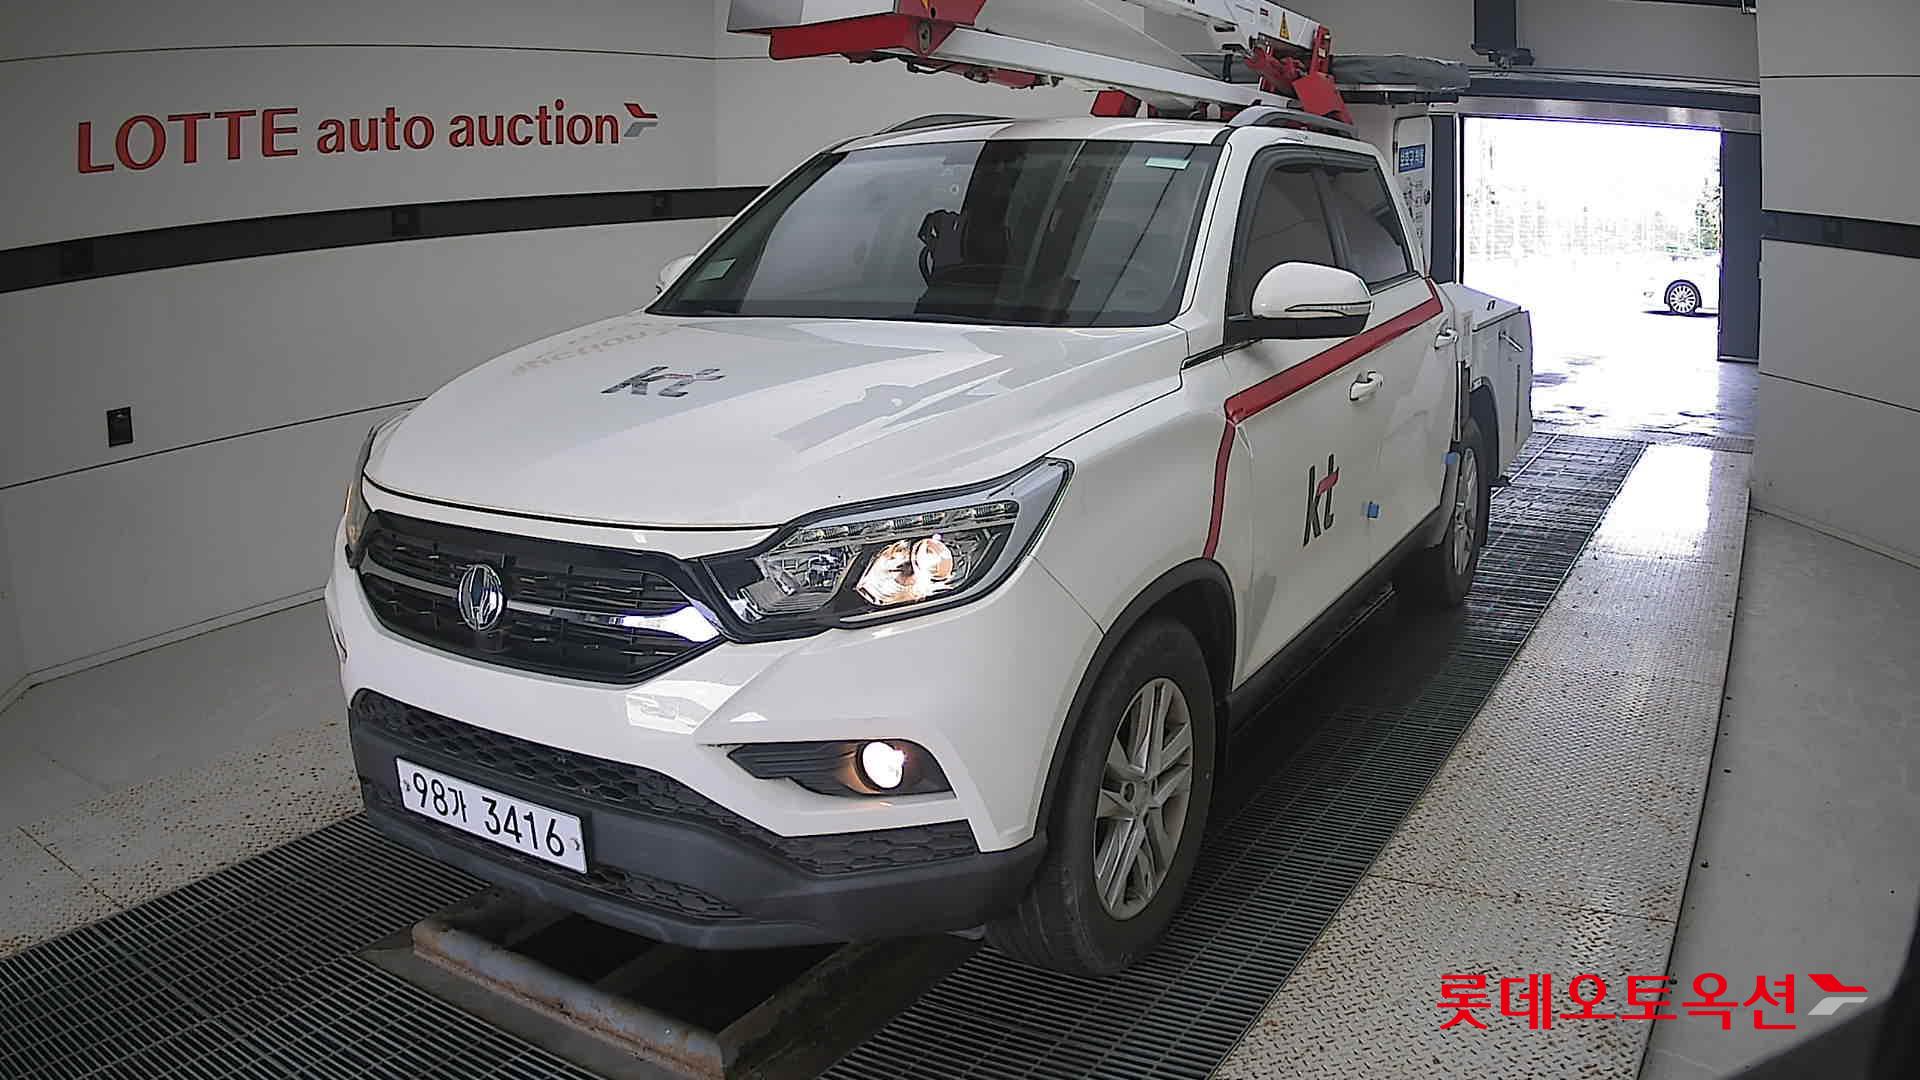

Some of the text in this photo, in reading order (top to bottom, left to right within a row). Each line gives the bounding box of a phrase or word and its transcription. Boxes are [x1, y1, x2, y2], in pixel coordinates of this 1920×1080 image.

[77, 98, 620, 174] LOTTE auto auction
[1302, 453, 1340, 548] kt
[413, 772, 565, 857] 98가 3416
